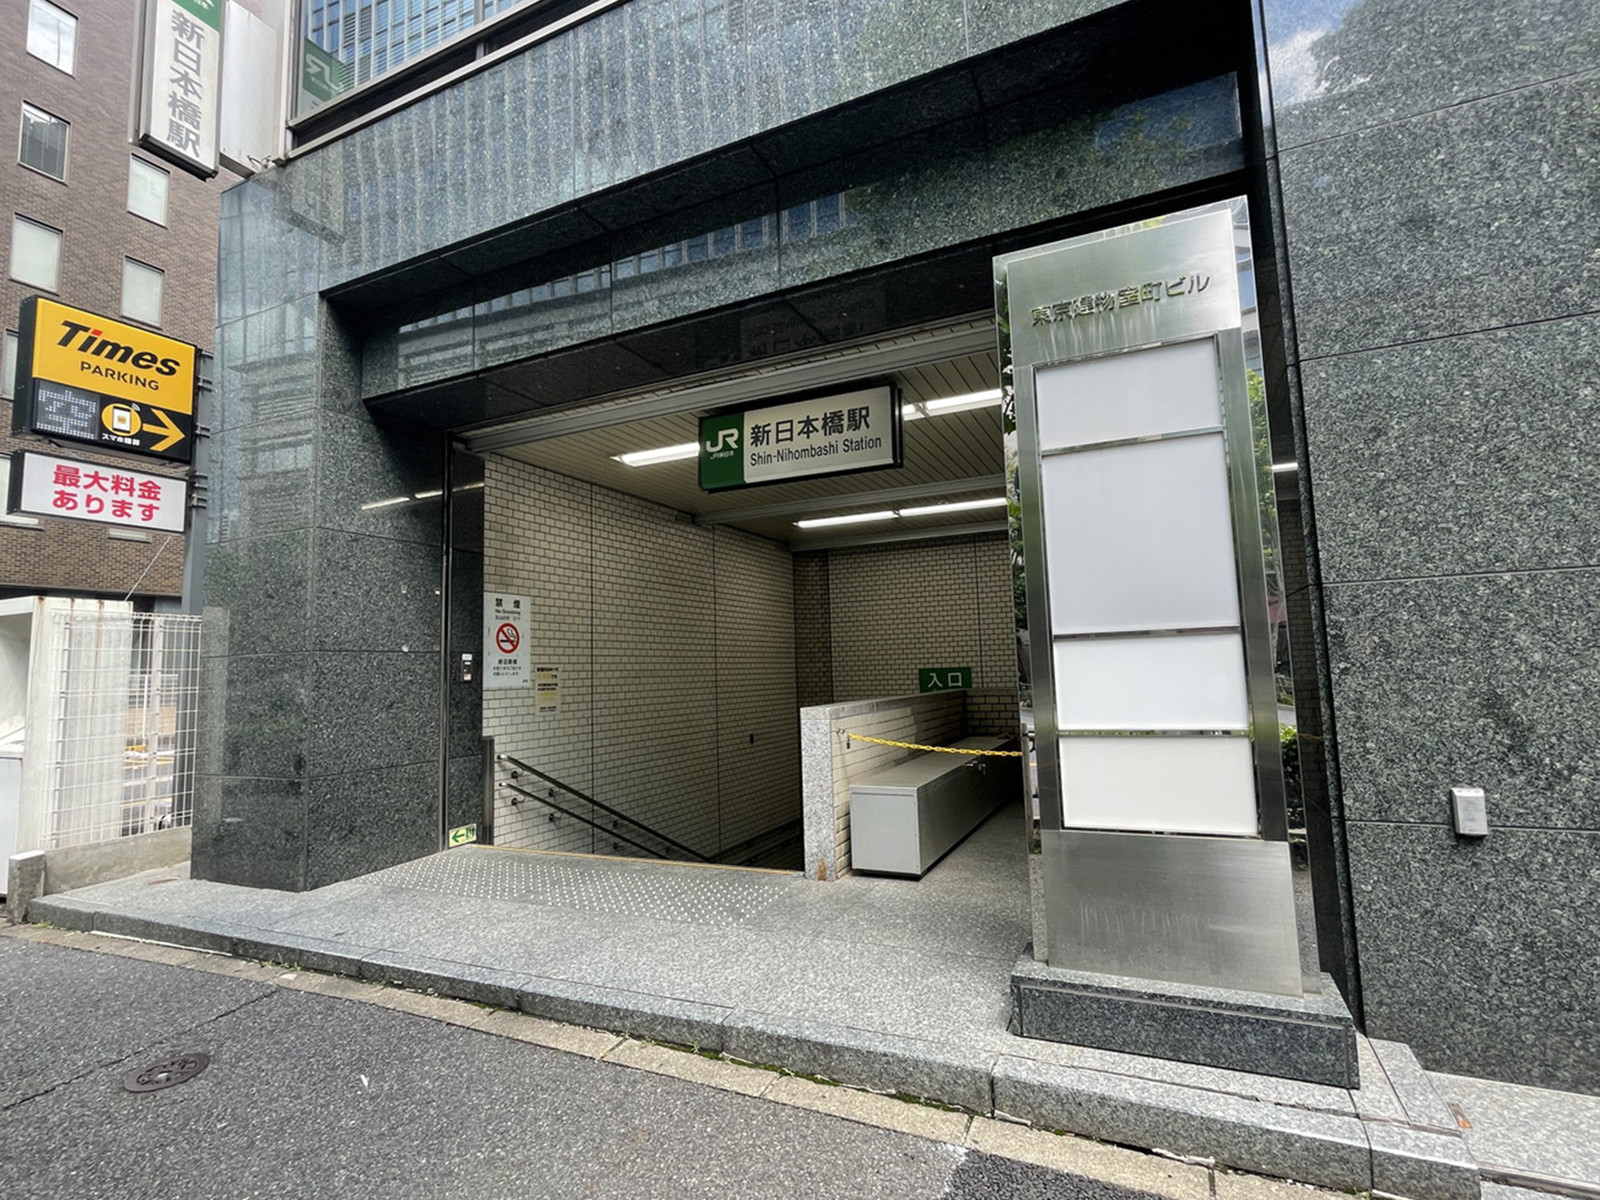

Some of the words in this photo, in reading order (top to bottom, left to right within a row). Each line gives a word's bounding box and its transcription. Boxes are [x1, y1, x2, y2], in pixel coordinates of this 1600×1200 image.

[167, 8, 205, 159] 新日本橋駅
[1030, 274, 1210, 327] 東京建物室町ビル
[57, 320, 181, 377] Times
[80, 361, 160, 391] PARKING
[705, 427, 739, 453] JR
[750, 405, 871, 448] 新日本橋駅
[750, 438, 839, 467] Shin-Nihombashi
[842, 435, 882, 453] Station
[52, 463, 163, 502] 最大料金
[52, 489, 160, 522] あります
[928, 672, 962, 688] 入口
